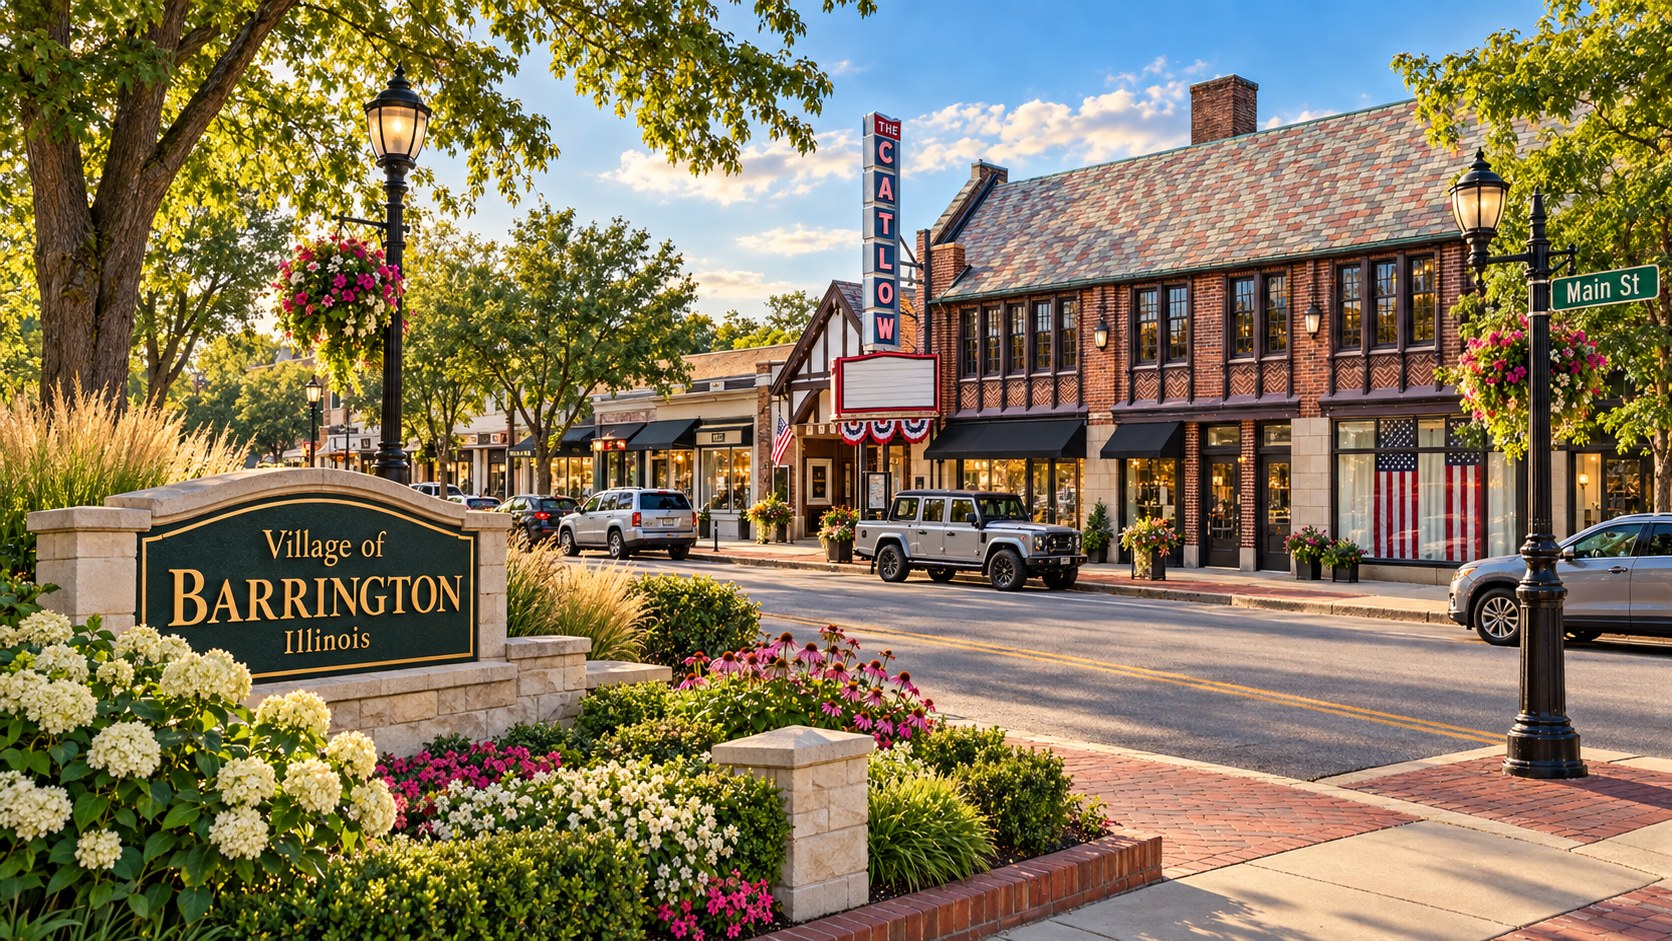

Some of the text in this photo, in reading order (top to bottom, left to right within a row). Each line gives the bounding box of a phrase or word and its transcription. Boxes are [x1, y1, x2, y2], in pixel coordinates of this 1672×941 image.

[878, 120, 898, 136] THE
[876, 140, 895, 340] CATLOW
[1566, 273, 1640, 304] Main St
[262, 529, 387, 567] Village of
[168, 568, 463, 627] BARRINGTON
[284, 626, 371, 654] Illinois
